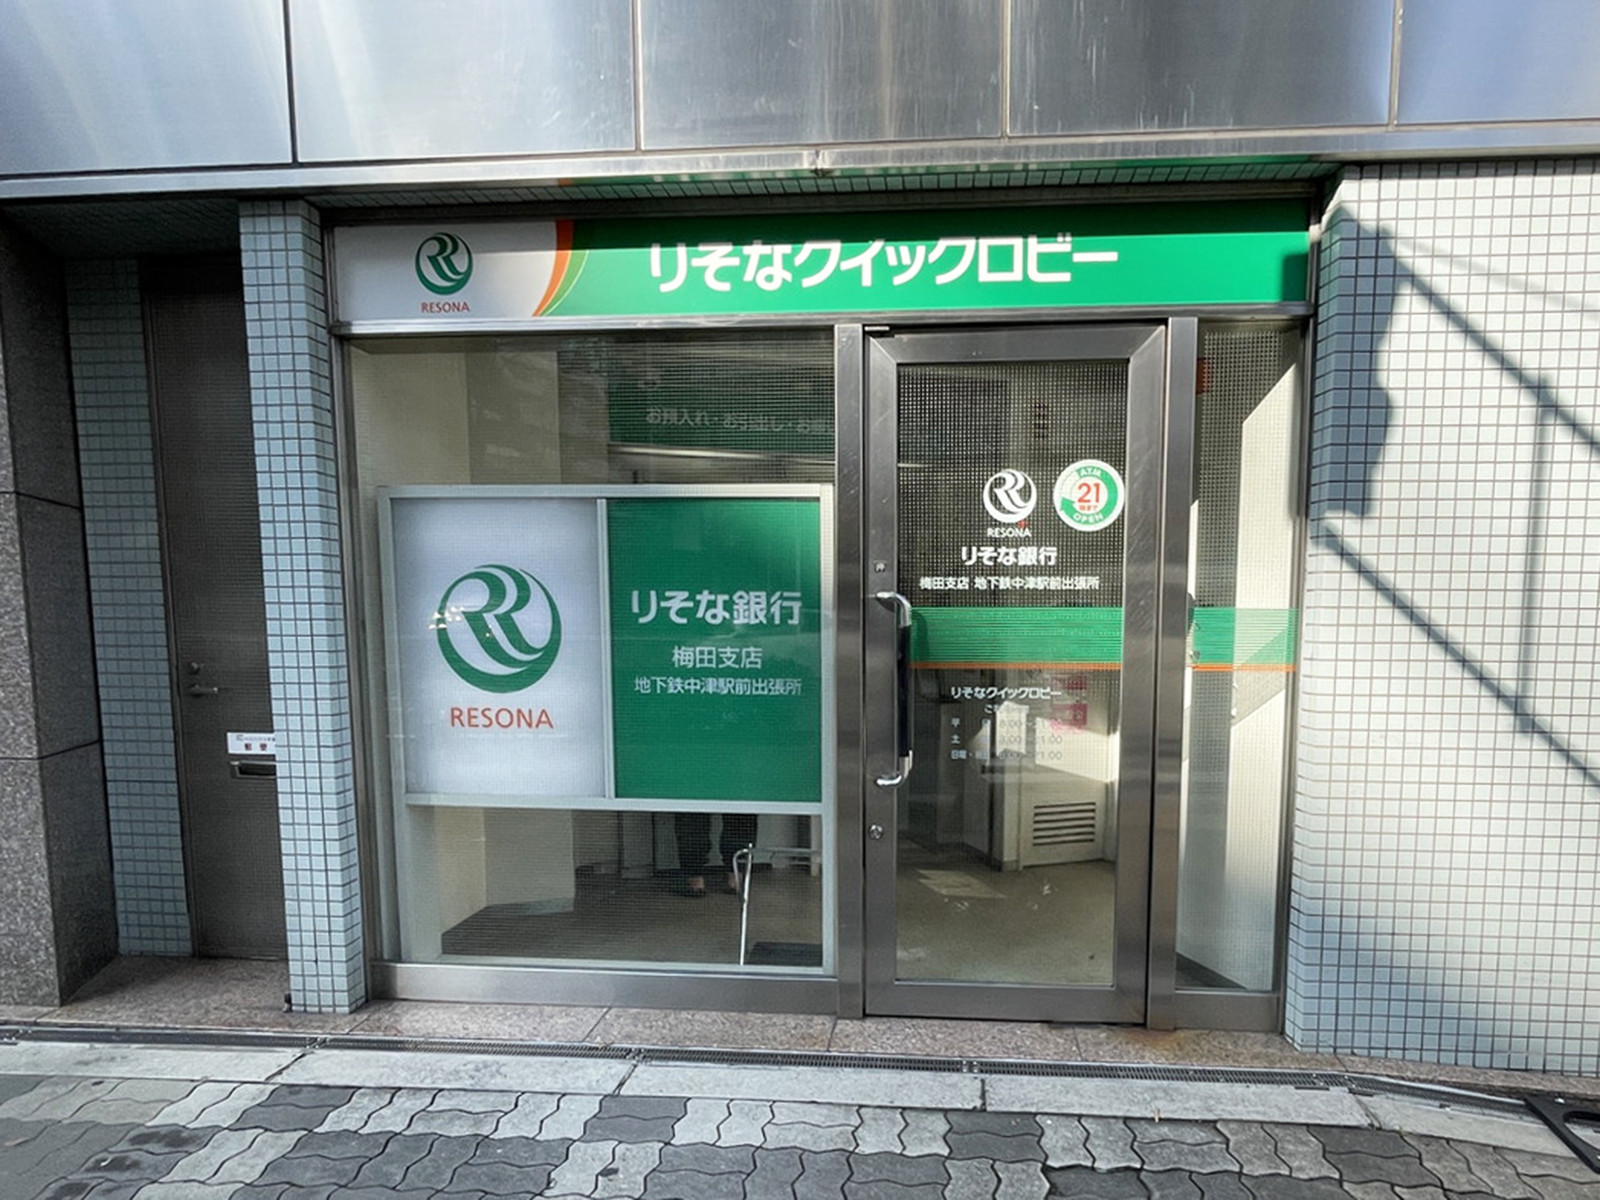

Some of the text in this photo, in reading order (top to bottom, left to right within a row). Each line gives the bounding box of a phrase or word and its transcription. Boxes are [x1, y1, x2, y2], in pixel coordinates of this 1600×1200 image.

[650, 233, 1119, 292] りそなクイックロビー
[421, 302, 470, 313] RESONA
[1077, 482, 1101, 503] 21
[1073, 511, 1104, 524] OPEN
[987, 527, 1032, 538] RESONA
[961, 546, 1057, 566] りそな銀行
[919, 576, 1100, 590] 梅田支店 地下鉄中津駅前出張所
[631, 590, 802, 625] りそな銀行
[672, 646, 763, 669] 梅田支店
[634, 676, 803, 695] 地下鉄中津駅前出張所
[951, 686, 1062, 700] りそなクイックロビー
[450, 707, 554, 729] RESONA
